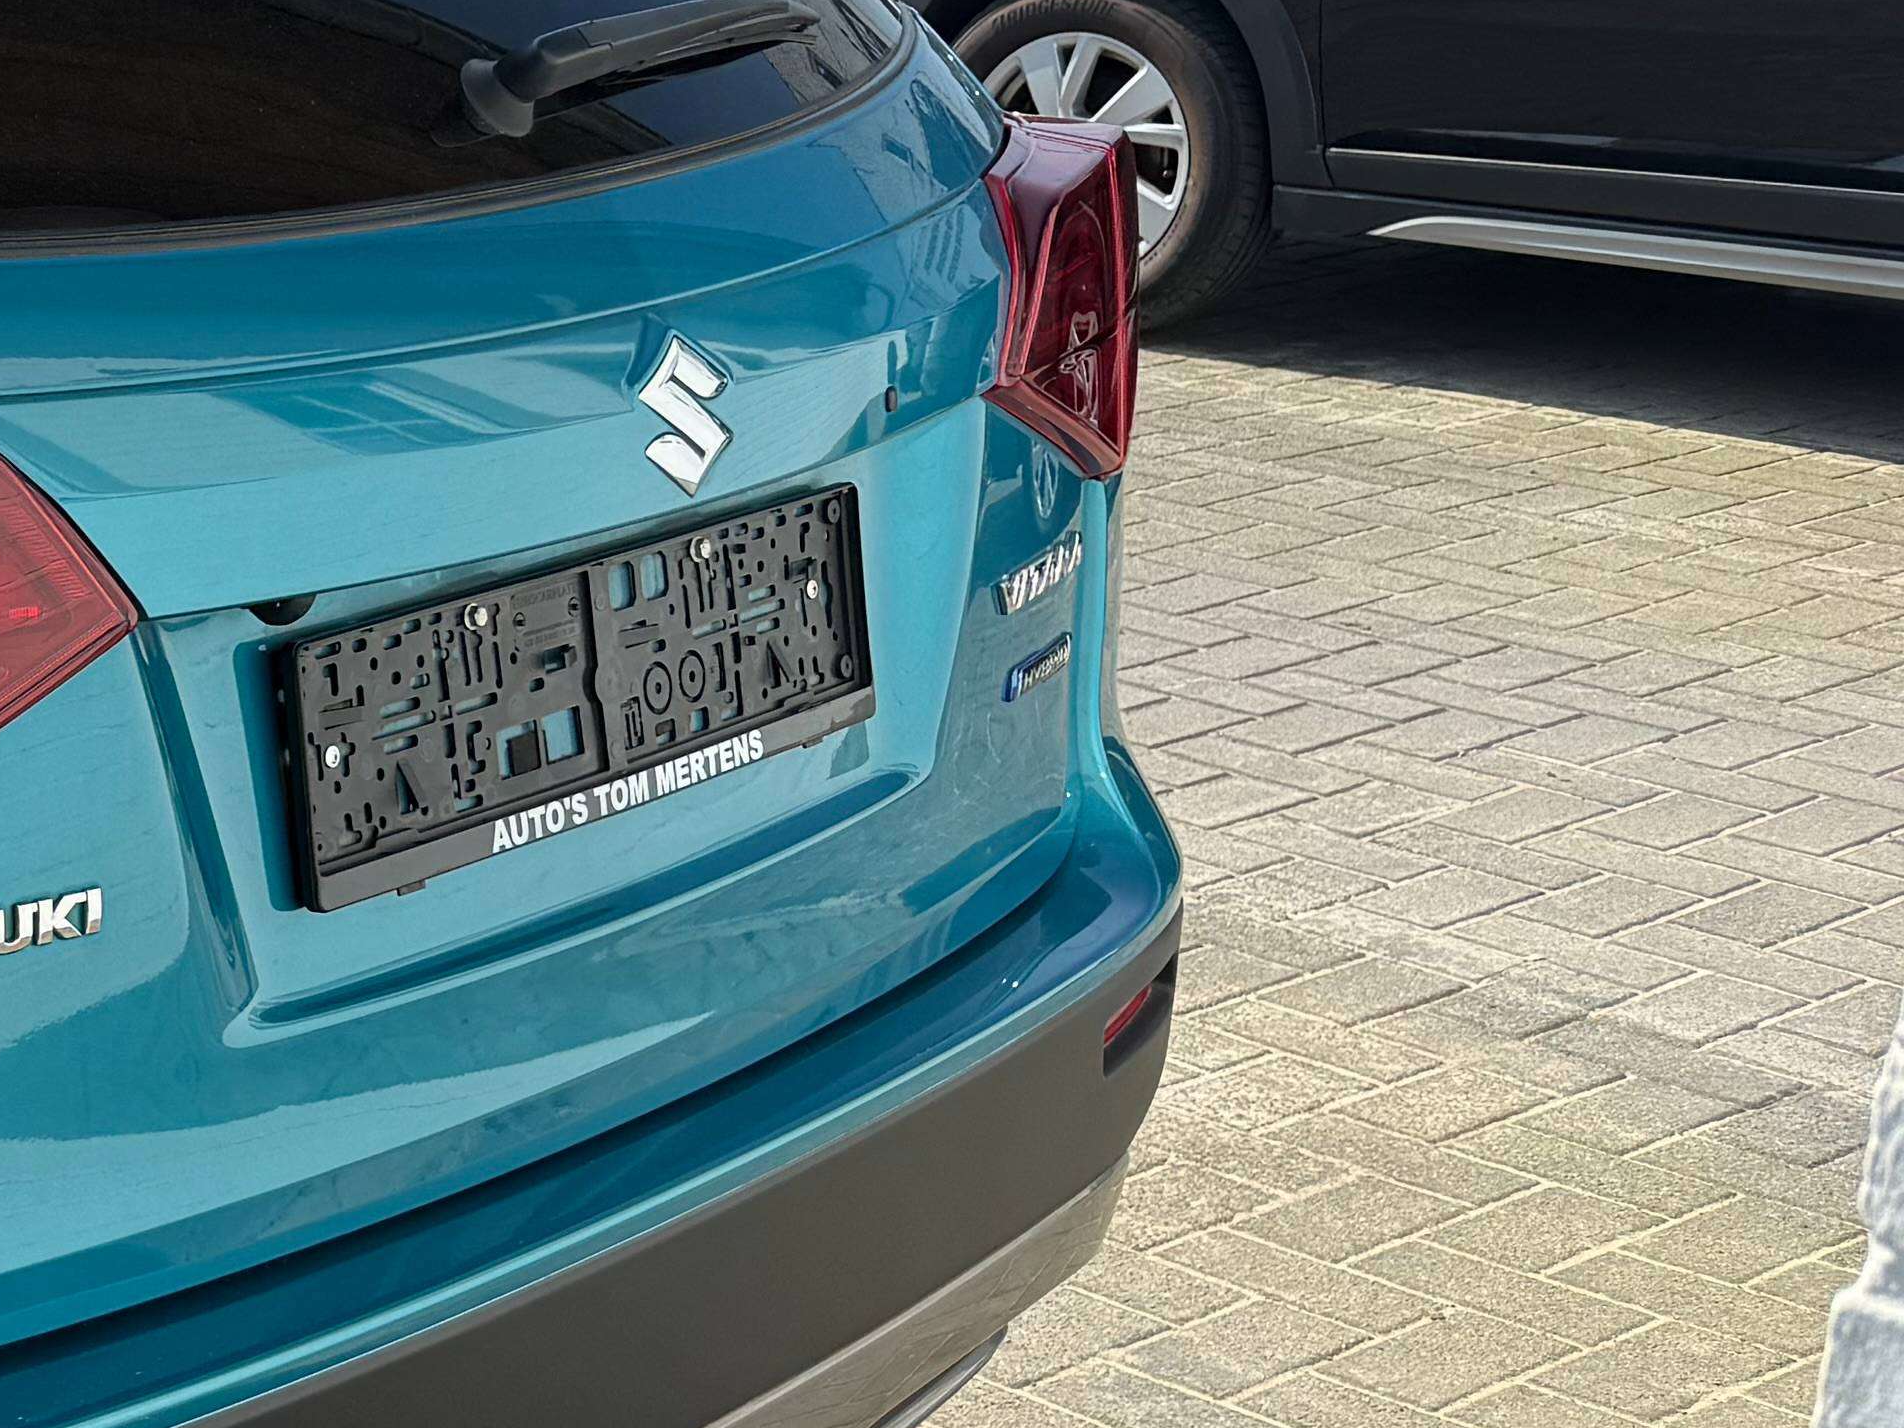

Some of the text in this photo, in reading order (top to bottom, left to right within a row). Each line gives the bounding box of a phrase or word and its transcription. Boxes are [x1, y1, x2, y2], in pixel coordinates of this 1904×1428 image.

[492, 729, 765, 854] AUTO'S TOM MERTENS
